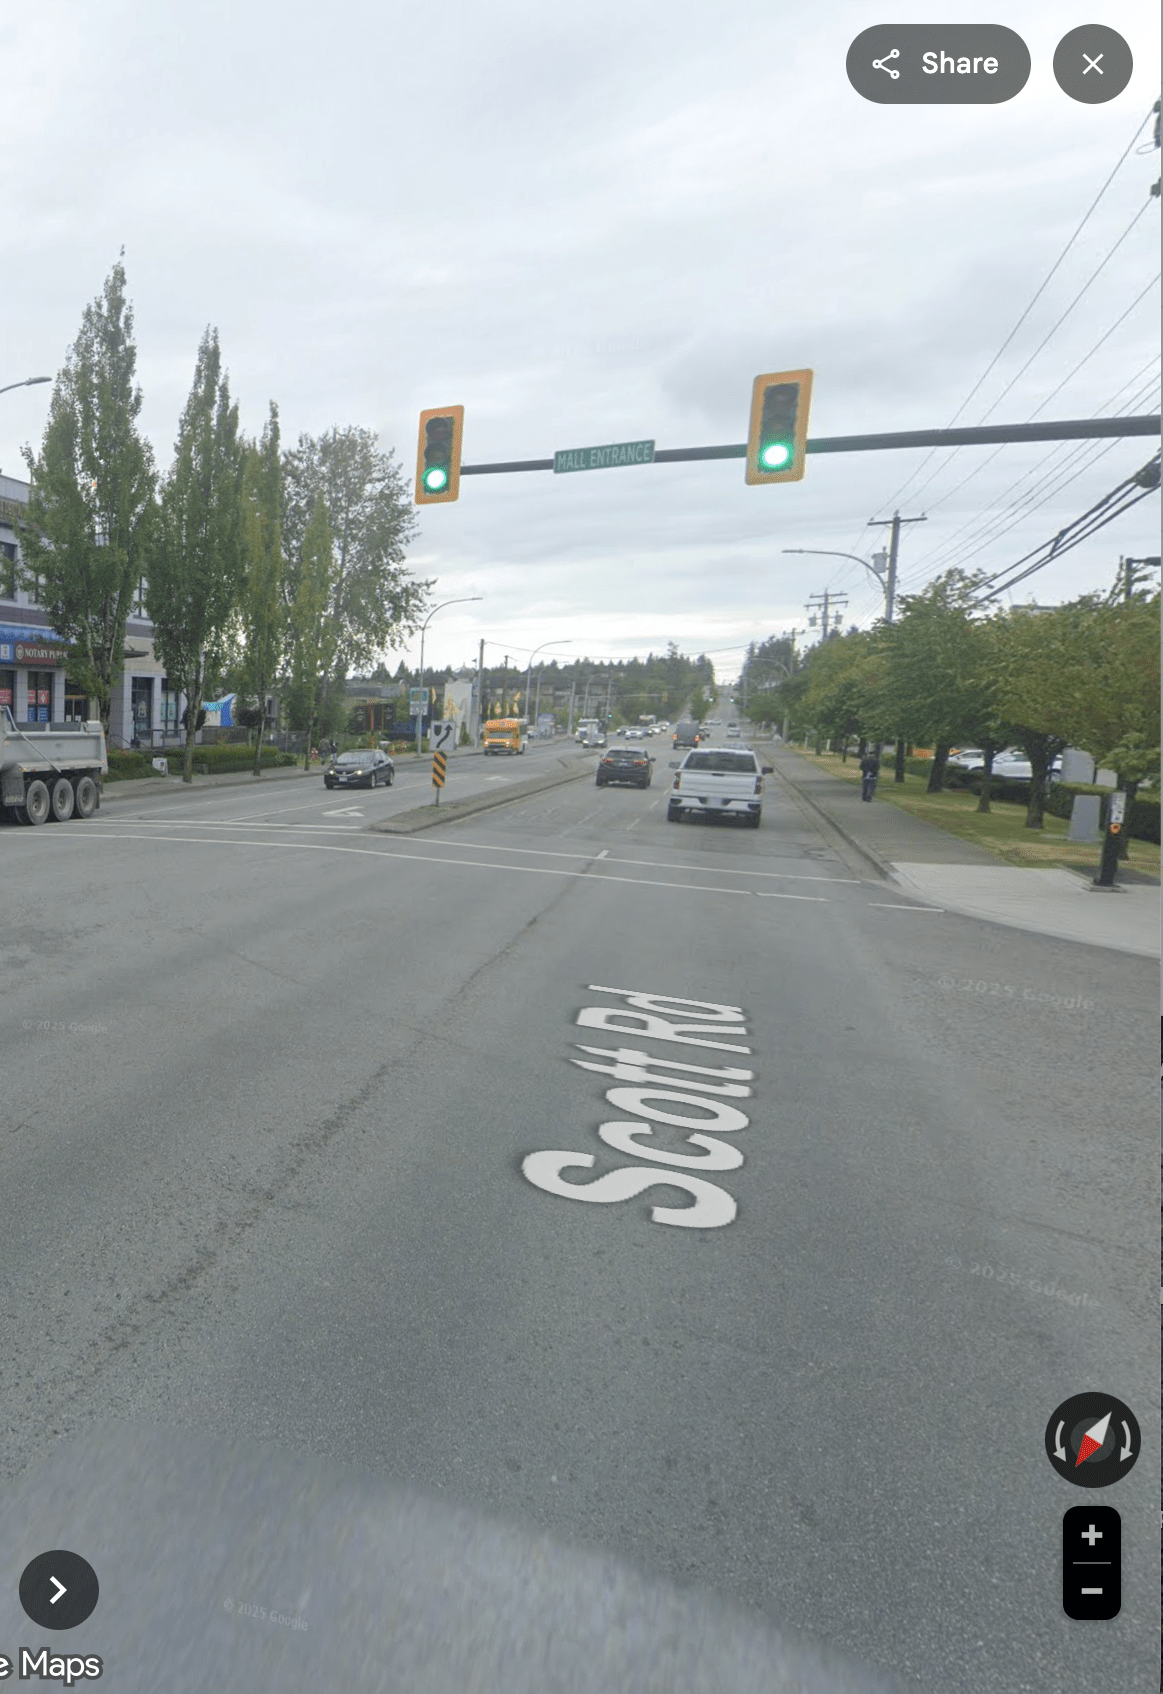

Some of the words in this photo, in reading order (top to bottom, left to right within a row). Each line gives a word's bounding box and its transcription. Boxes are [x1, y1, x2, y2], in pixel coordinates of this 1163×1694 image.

[557, 452, 586, 470] MALL
[590, 443, 652, 467] ENTRANCE
[24, 647, 49, 658] NOTARY
